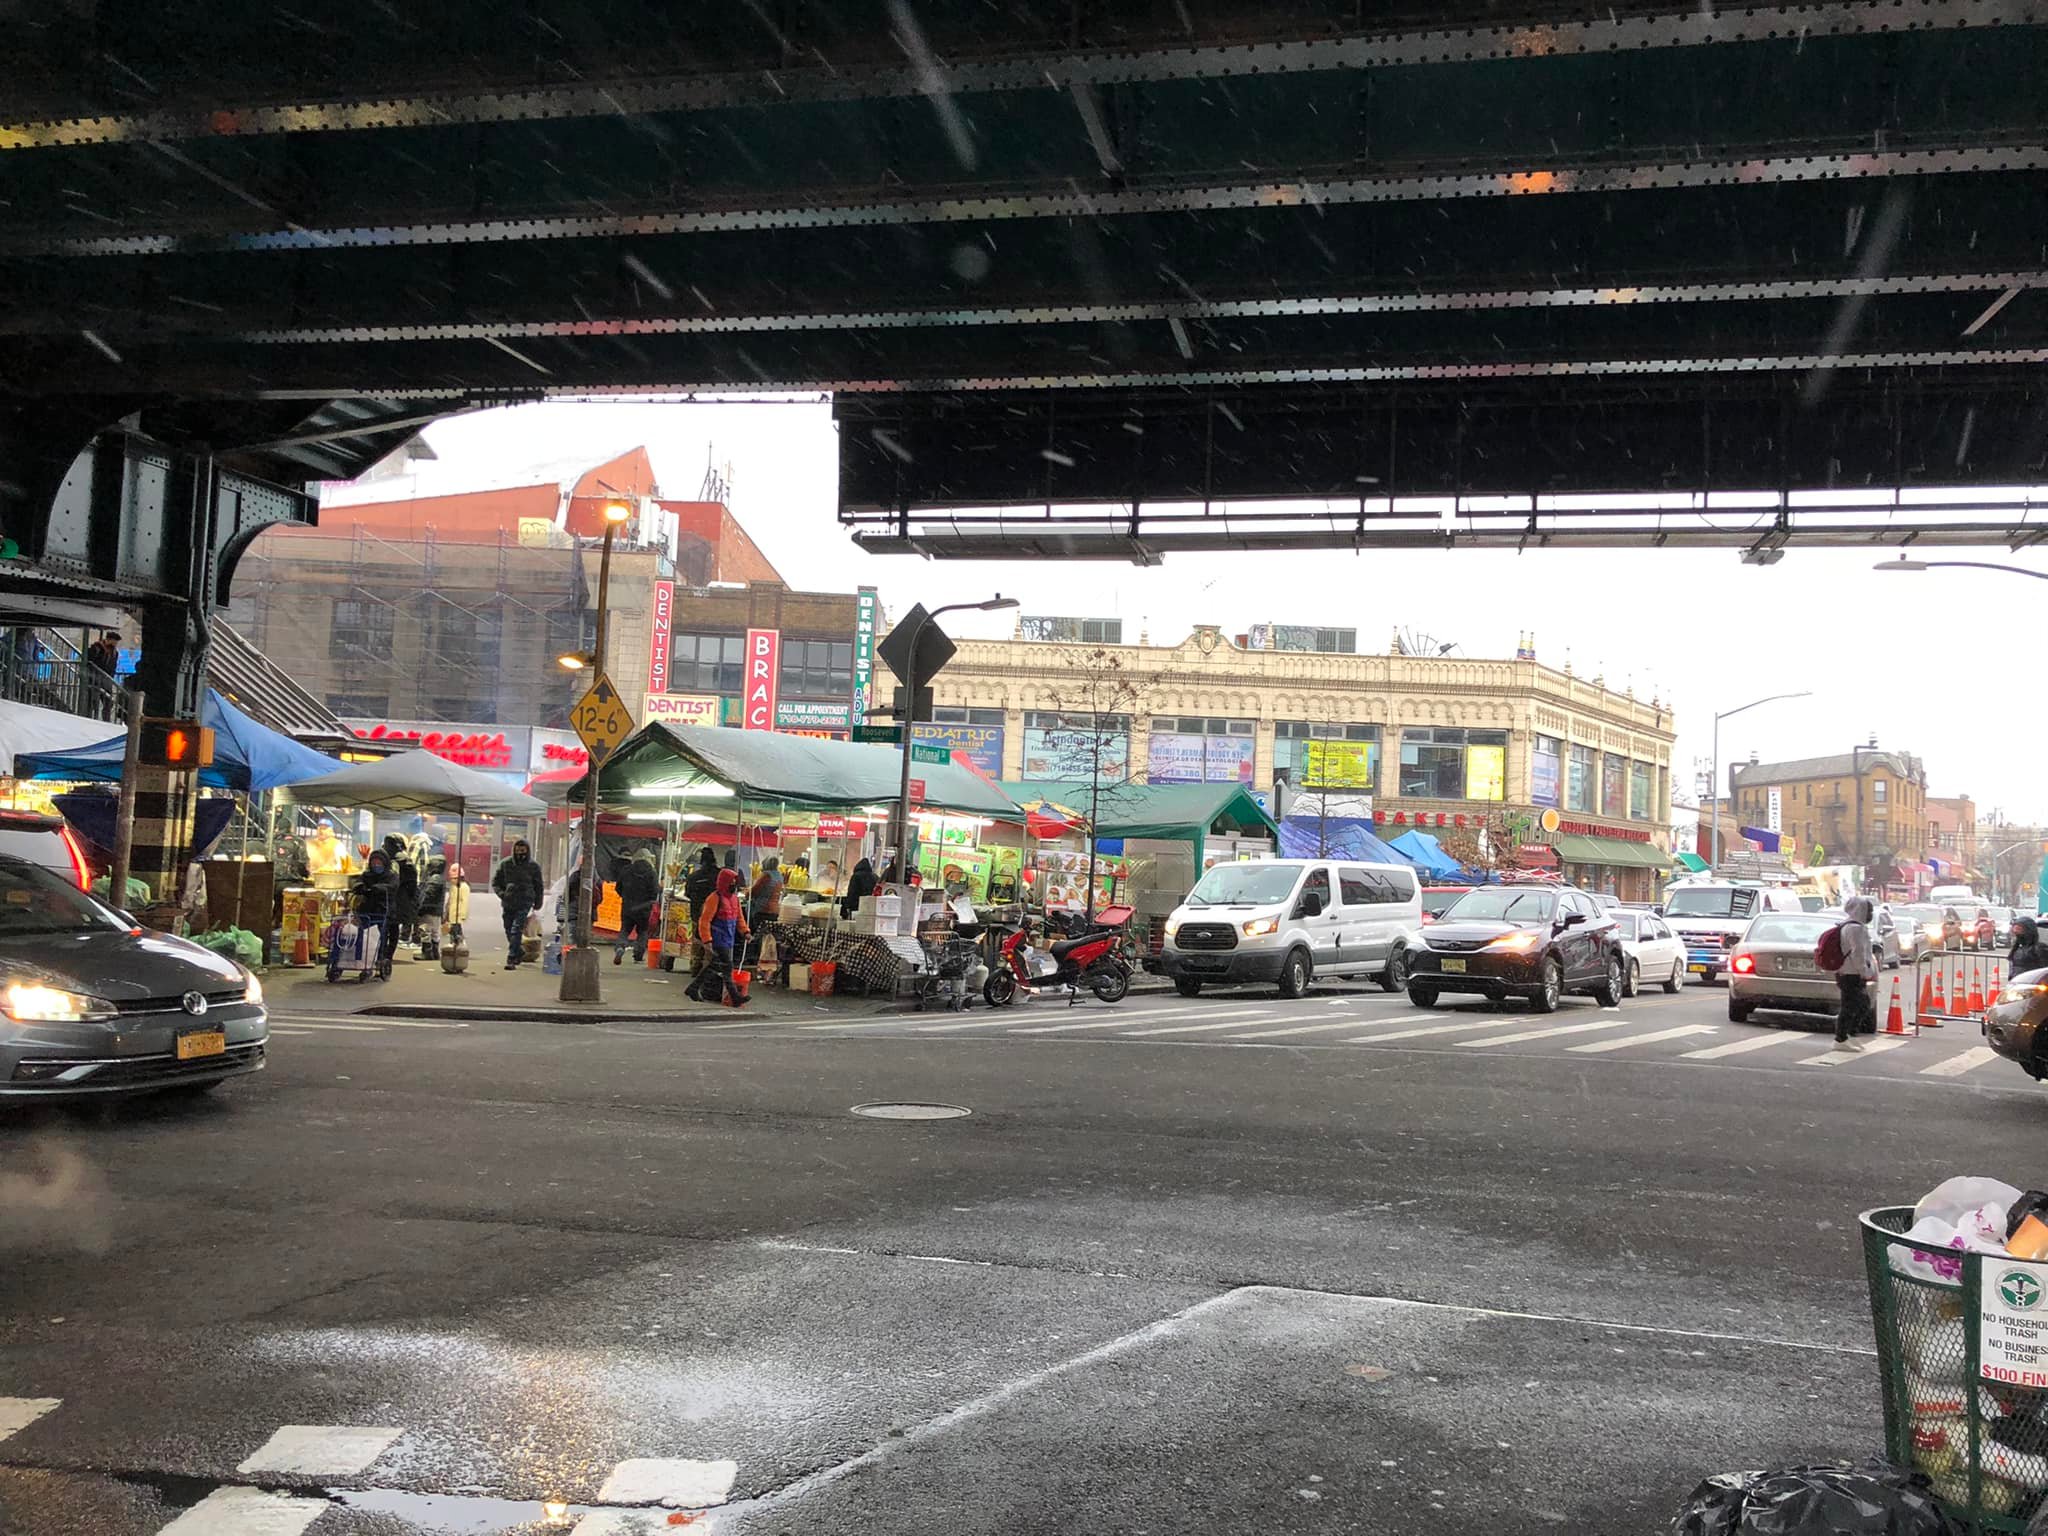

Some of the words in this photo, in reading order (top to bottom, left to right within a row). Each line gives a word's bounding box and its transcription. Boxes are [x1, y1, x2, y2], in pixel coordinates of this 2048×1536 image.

[652, 588, 669, 689] DENTIST
[856, 597, 873, 682] DENTIST
[751, 636, 770, 730] BRAC
[648, 698, 714, 715] DENTIST
[778, 703, 794, 714] CALL
[794, 704, 806, 714] FOR
[807, 705, 849, 715] APPOINTMENT
[860, 727, 895, 737] Roosevelt
[948, 739, 985, 748] Dentist
[1373, 810, 1487, 827] BAKERY
[1520, 844, 1548, 852] BAKERY
[1982, 1312, 1996, 1323] NO
[2004, 1326, 2038, 1340] TRASH
[1988, 1338, 2002, 1349] NO
[2005, 1342, 2048, 1355] BUSINES
[2003, 1351, 2038, 1365] TRASH
[1982, 1364, 2018, 1383] $100
[2022, 1371, 2047, 1386] FIN
